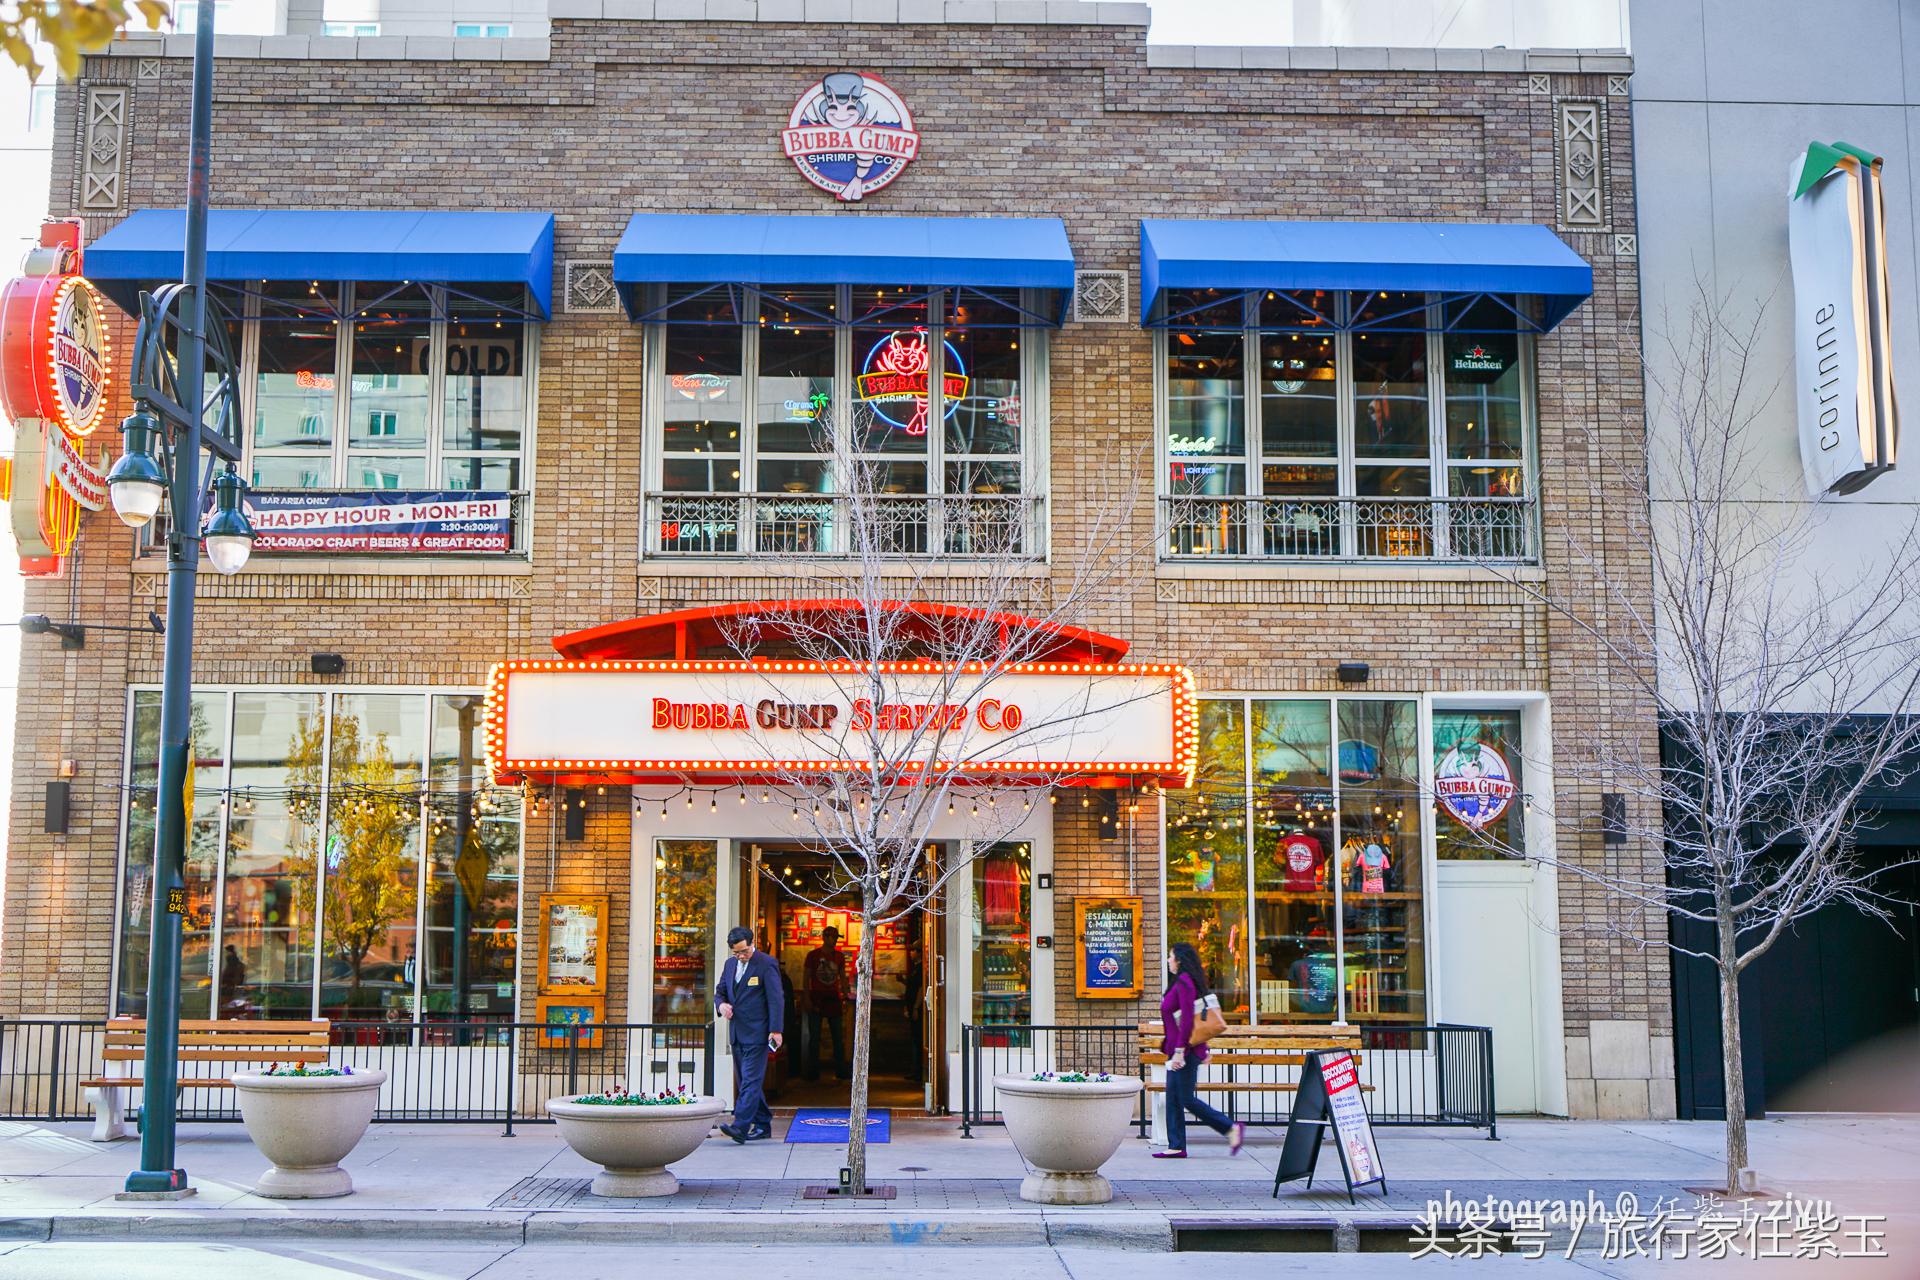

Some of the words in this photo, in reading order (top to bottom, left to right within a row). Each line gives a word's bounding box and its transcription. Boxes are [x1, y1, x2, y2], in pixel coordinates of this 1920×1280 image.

[788, 131, 853, 152] BUBBA
[860, 128, 914, 154] GUMP
[808, 153, 856, 163] SHRIMP
[796, 156, 842, 191] RESTAURANT
[873, 161, 903, 186] MARKET
[58, 338, 81, 367] BUBBA
[82, 352, 101, 387] GUMP
[1455, 360, 1502, 369] Heineken
[64, 367, 81, 383] SHRIMP
[672, 375, 700, 388] Coors
[1815, 303, 1840, 451] corinne
[867, 374, 918, 394] BUBBA
[920, 374, 964, 395] GMP
[784, 400, 813, 410] Corona
[875, 394, 912, 403] SHRIMP
[61, 437, 106, 487] RESTAURAN
[70, 472, 105, 504] MARKET
[260, 496, 279, 505] BAR
[280, 496, 305, 505] AREA
[306, 496, 330, 505] ONLY
[260, 512, 328, 527] HAPPY
[334, 509, 391, 525] HOUR
[412, 503, 497, 520] MON-FRI
[440, 522, 499, 532] 3:30-6:30PM
[254, 536, 323, 547] COLORADO
[326, 536, 369, 547] CRAFT
[369, 536, 409, 547] BEERS
[411, 536, 420, 547] &
[423, 536, 465, 547] GREAT
[466, 536, 505, 547] FOOD!
[652, 698, 749, 729] BUBBA
[756, 699, 839, 730] GUMP
[851, 699, 968, 731] SHRIMP
[978, 698, 1022, 731] CO
[1438, 780, 1476, 795] BUBBA
[1479, 780, 1511, 798] GUMP
[169, 903, 185, 914] 942
[1095, 920, 1128, 928] MARKET
[1322, 1059, 1354, 1081] DISCOUNTED
[1330, 1072, 1353, 1090] PARKING
